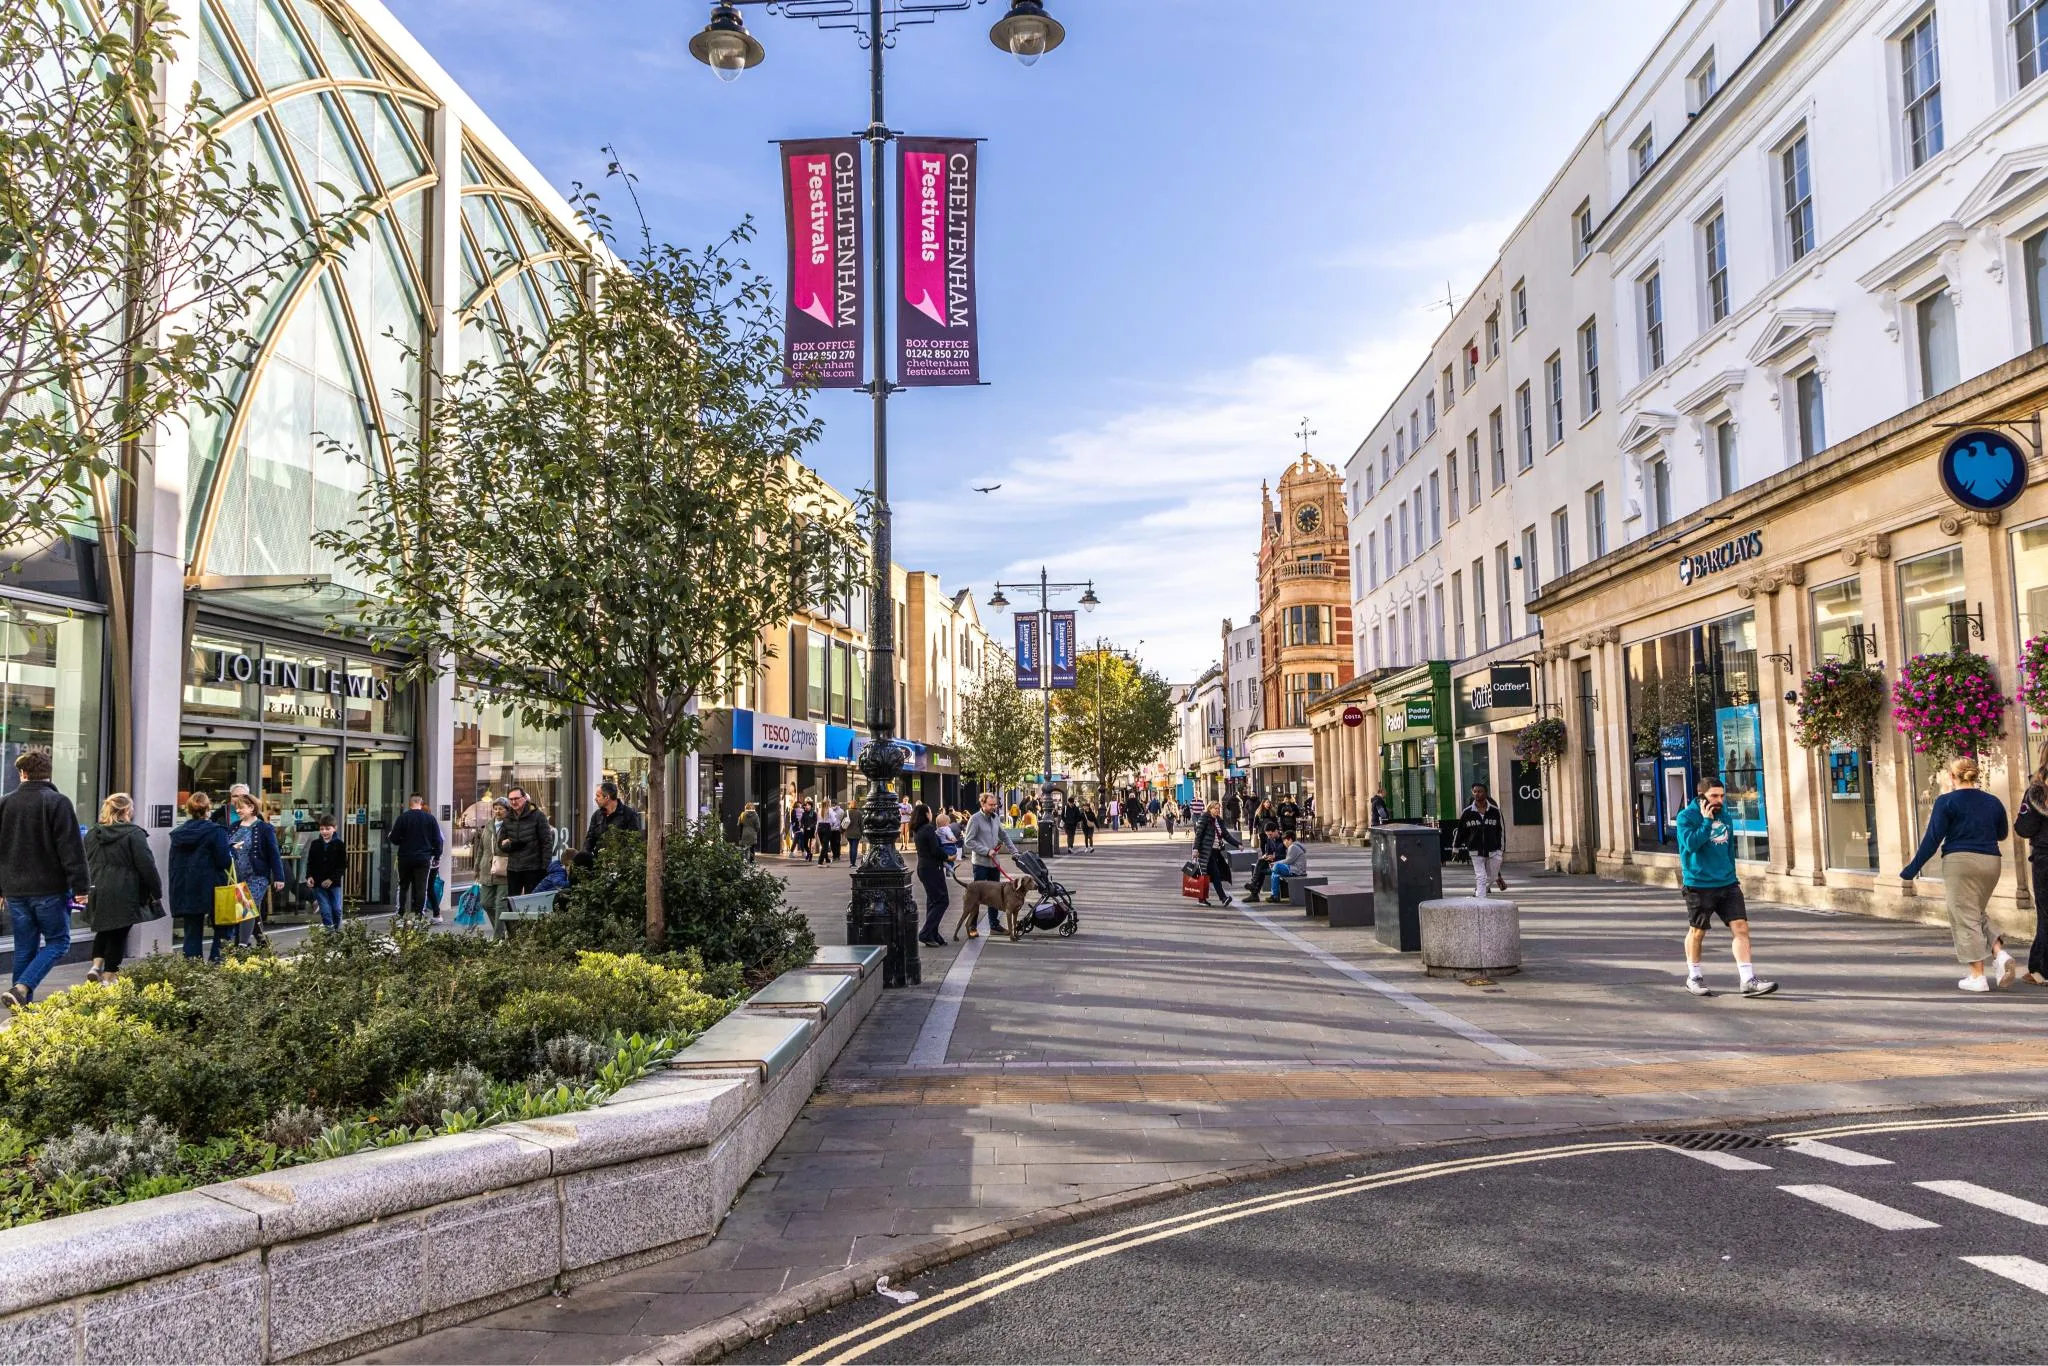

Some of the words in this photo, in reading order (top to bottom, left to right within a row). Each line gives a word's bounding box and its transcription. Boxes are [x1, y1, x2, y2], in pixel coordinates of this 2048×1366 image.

[808, 162, 829, 265] Festivals
[922, 159, 941, 262] Festivals
[835, 152, 856, 328] CHELTENHAM
[949, 153, 969, 328] CHELTENHAM
[793, 342, 815, 351] BOX
[817, 340, 856, 350] OFFICE
[906, 339, 928, 348] BOX
[930, 340, 969, 349] OFFICE
[906, 349, 933, 358] 01242
[935, 349, 951, 358] 850
[953, 349, 970, 358] 270
[792, 351, 819, 361] 01242
[820, 351, 837, 360] 850
[839, 350, 855, 360] 270
[906, 359, 970, 367] cheltenham
[906, 367, 970, 376] festivals.com
[1694, 530, 1763, 578] BARCLAYS
[216, 651, 300, 689] JOHN
[312, 667, 390, 701] LEWIS
[270, 702, 277, 713] &
[762, 723, 790, 743] TESCO
[791, 729, 817, 750] express
